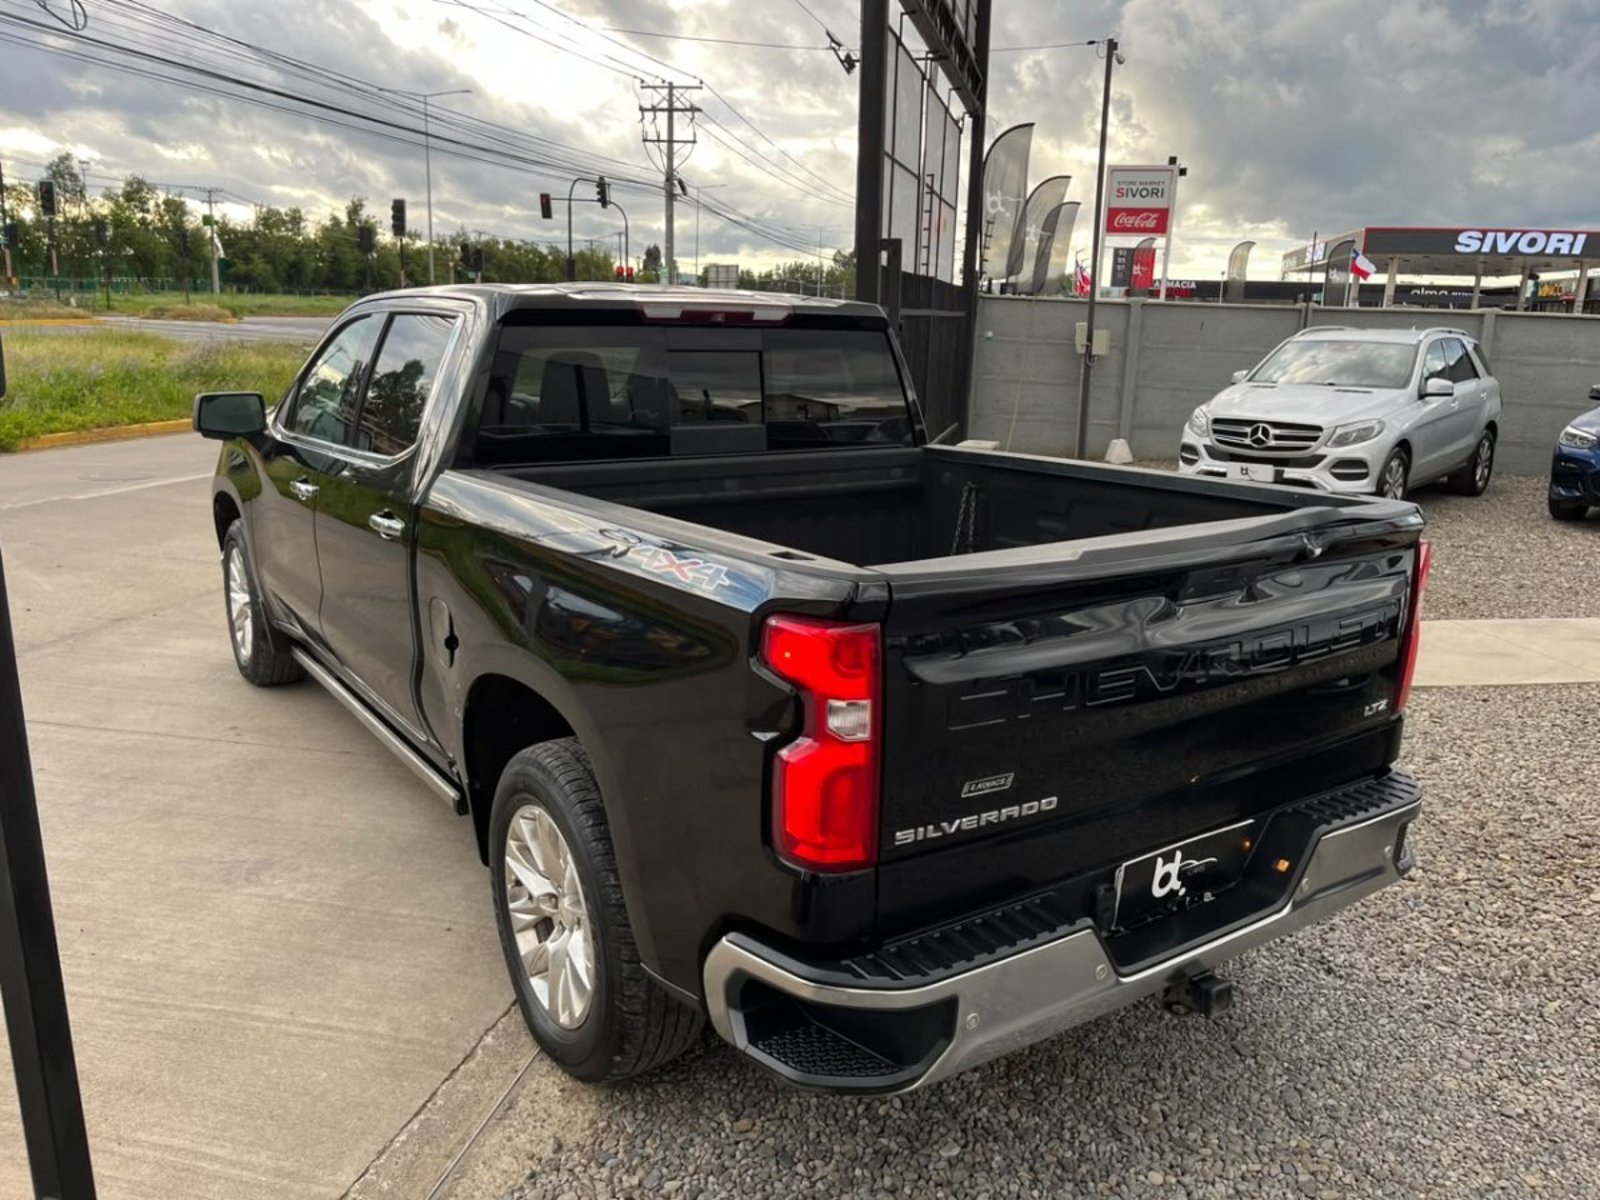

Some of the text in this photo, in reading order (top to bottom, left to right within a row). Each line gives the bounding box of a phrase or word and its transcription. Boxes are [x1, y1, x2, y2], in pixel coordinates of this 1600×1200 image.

[1116, 187, 1165, 198] SIVORI
[1454, 230, 1588, 255] SIVORI
[947, 606, 1393, 731] CHEVROLET
[1364, 698, 1388, 717] LTZ
[894, 796, 1058, 846] SILVERADO
